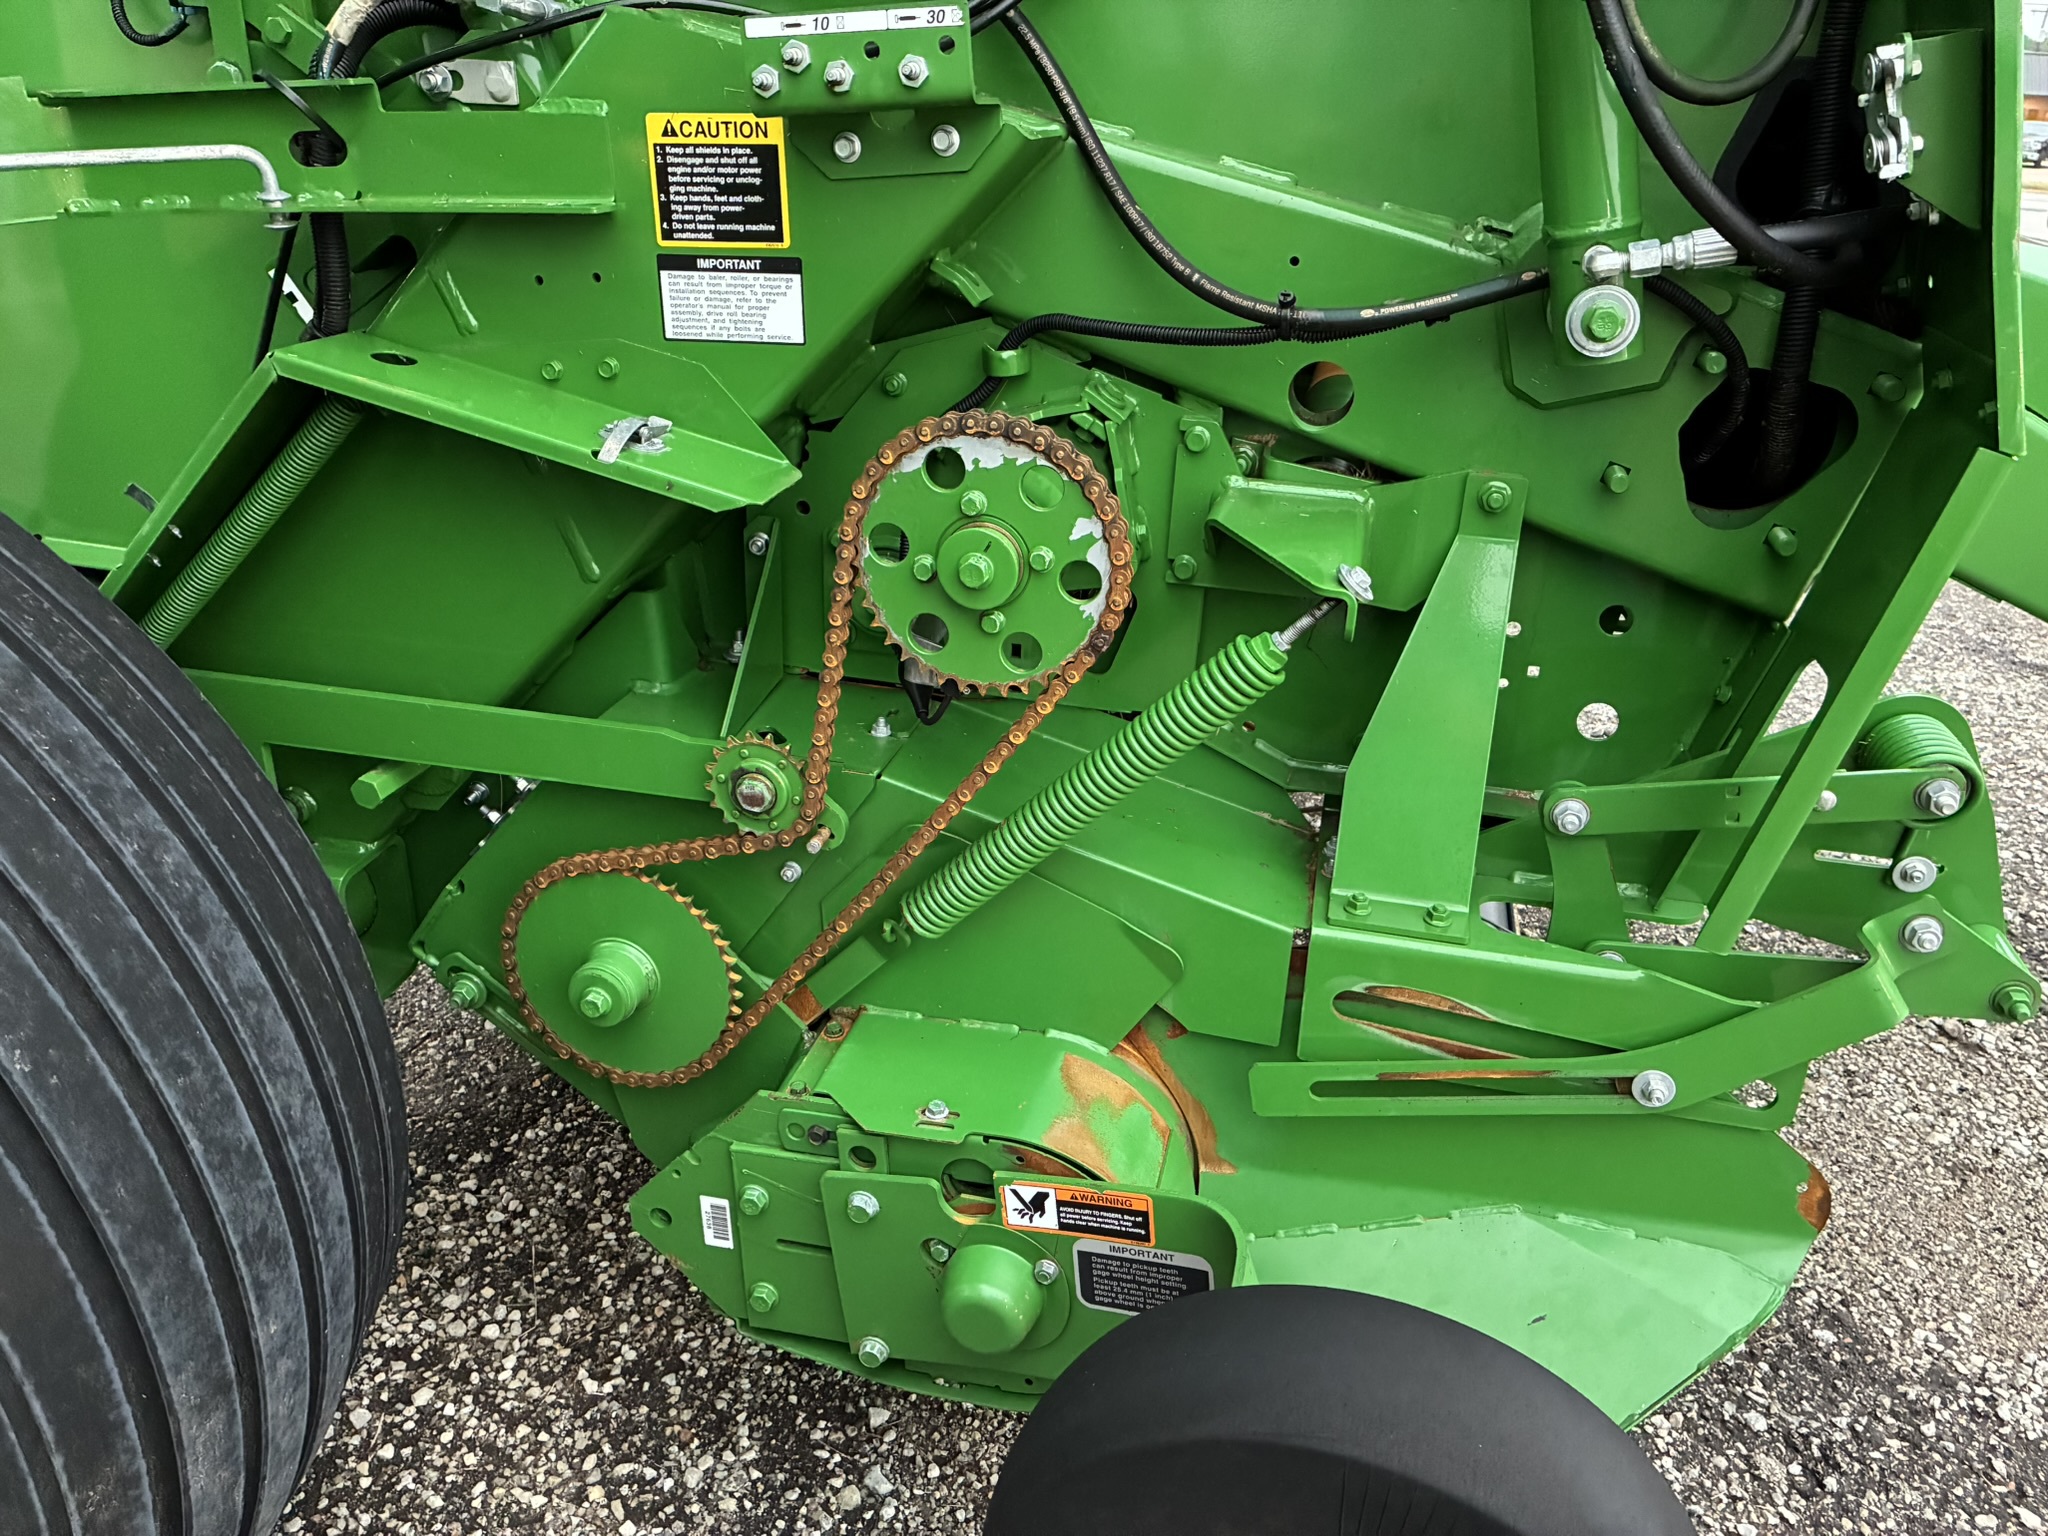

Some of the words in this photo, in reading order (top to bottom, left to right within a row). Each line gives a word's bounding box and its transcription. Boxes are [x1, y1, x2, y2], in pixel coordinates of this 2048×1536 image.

[926, 9, 946, 24] 30
[812, 16, 830, 31] 10
[680, 120, 768, 138] CAUTION
[656, 145, 663, 154] 1.
[666, 146, 684, 155] Keep
[696, 146, 721, 154] shields
[731, 146, 753, 156] place.
[656, 155, 664, 163] 2.
[666, 156, 704, 165] Disengage
[668, 166, 692, 174] engine
[1018, 24, 1032, 40] 22.5
[1028, 38, 1040, 56] MPa
[1084, 138, 1096, 150] ISO
[1091, 150, 1108, 172] 11237
[1104, 172, 1117, 186] R17
[1114, 190, 1128, 204] SAE
[1123, 203, 1144, 227] 100R17
[1144, 230, 1156, 242] ISO
[1152, 240, 1173, 260] 18752
[1170, 256, 1185, 272] Type
[1184, 268, 1192, 276] B
[1200, 278, 1220, 294] Flame
[1221, 290, 1254, 308] Resistant
[1254, 302, 1277, 315] MSHA
[668, 174, 691, 182] before
[692, 175, 725, 185] servicing
[736, 176, 763, 185] unclog-
[669, 184, 685, 194] ging
[686, 184, 718, 192] machine.
[670, 194, 688, 203] Keep
[689, 194, 713, 202] hands,
[670, 203, 682, 212] ing
[720, 205, 745, 213] power-
[695, 214, 716, 222] parts.
[716, 223, 744, 232] running
[696, 258, 762, 270] IMPORTANT
[668, 272, 694, 281] Damage
[764, 276, 793, 284] bearings
[1380, 302, 1416, 314] POWERING
[1079, 1194, 1132, 1208] WARNING
[1109, 1245, 1174, 1262] IMPORTANT
[1092, 1256, 1120, 1266] Damage
[1132, 1263, 1158, 1272] pickup
[1160, 1267, 1178, 1275] teeth
[1112, 1272, 1134, 1280] wheel
[1136, 1275, 1158, 1284] height
[1150, 1272, 1182, 1282] improper
[1093, 1276, 1118, 1286] Pickup
[1140, 1285, 1158, 1293] must
[1094, 1282, 1111, 1290] least
[1118, 1294, 1144, 1302] ground
